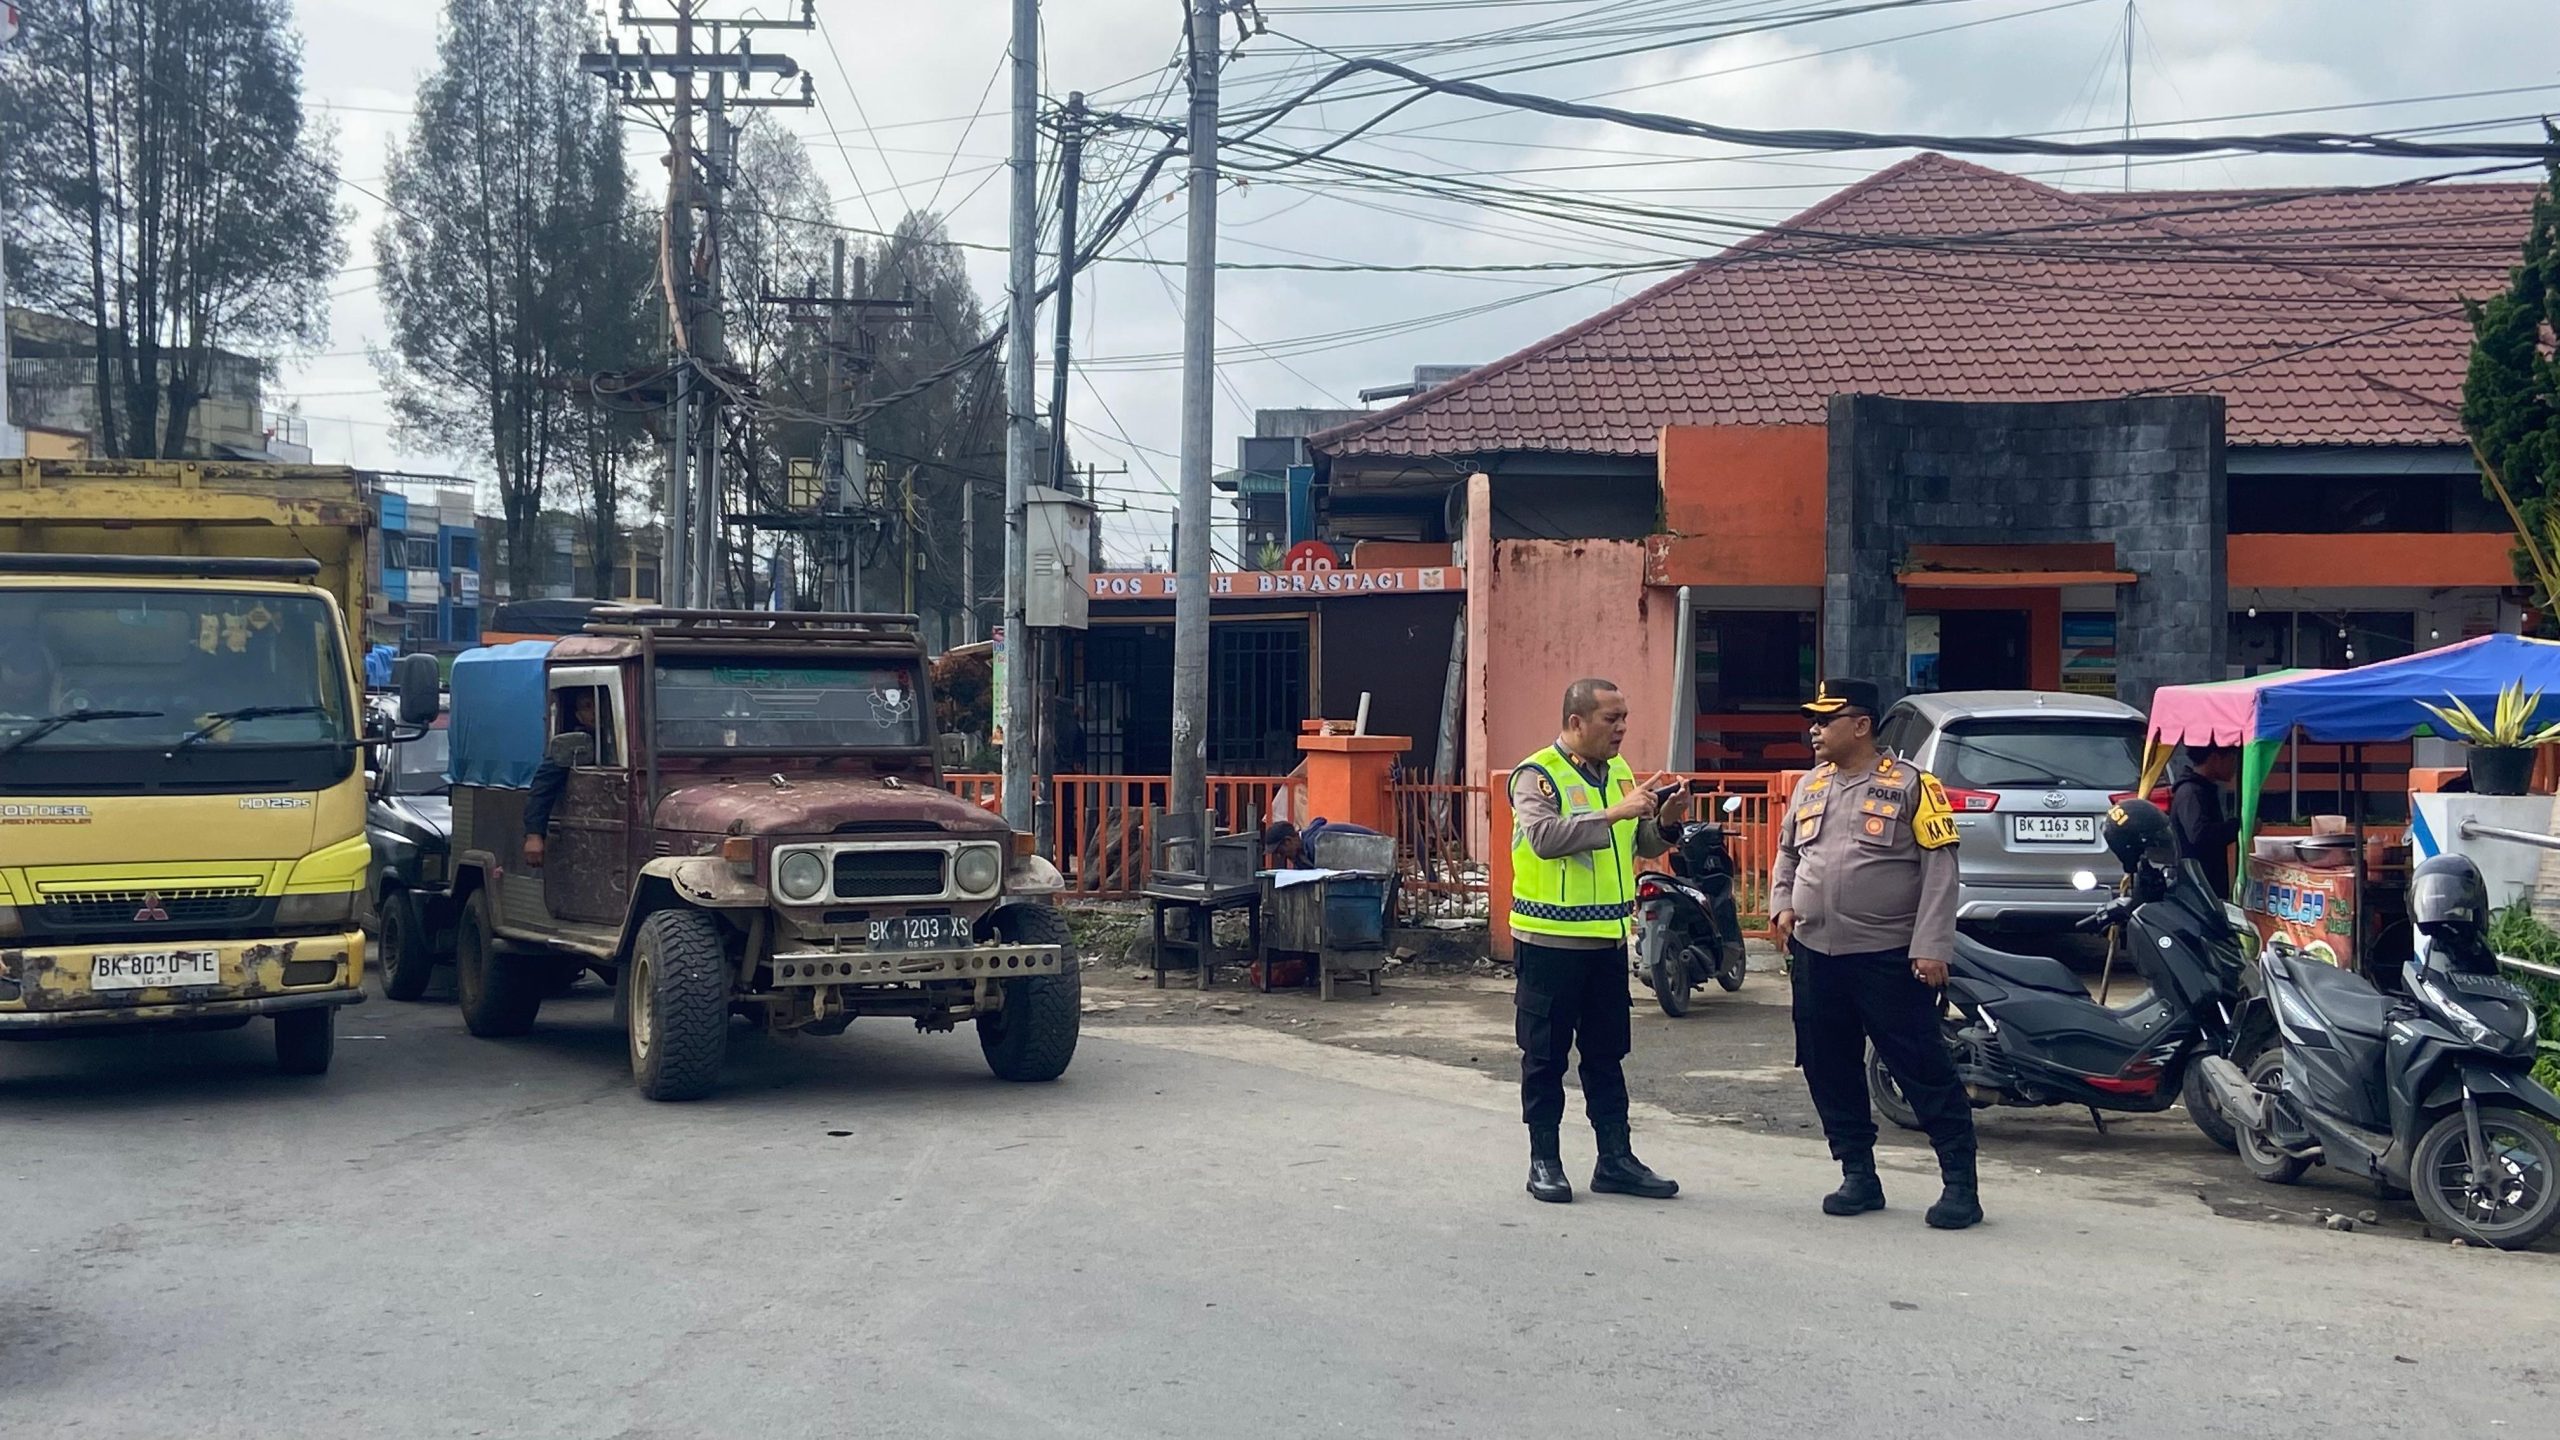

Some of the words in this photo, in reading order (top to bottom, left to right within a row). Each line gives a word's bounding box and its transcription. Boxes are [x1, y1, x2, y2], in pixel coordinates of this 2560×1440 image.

[1095, 577, 1142, 595] POS
[1162, 576, 1233, 594] BH
[1258, 572, 1404, 592] BERASTAGI
[1867, 787, 1902, 802] POLRI
[39, 805, 91, 816] DIESEL
[1925, 820, 1944, 841] KA
[2019, 819, 2034, 831] BK
[2039, 819, 2069, 831] 1163
[2075, 819, 2090, 831] SR
[869, 919, 889, 941] BK
[903, 918, 939, 940] 1203
[951, 916, 969, 937] XS
[99, 957, 122, 977] BK
[191, 952, 214, 972] TE
